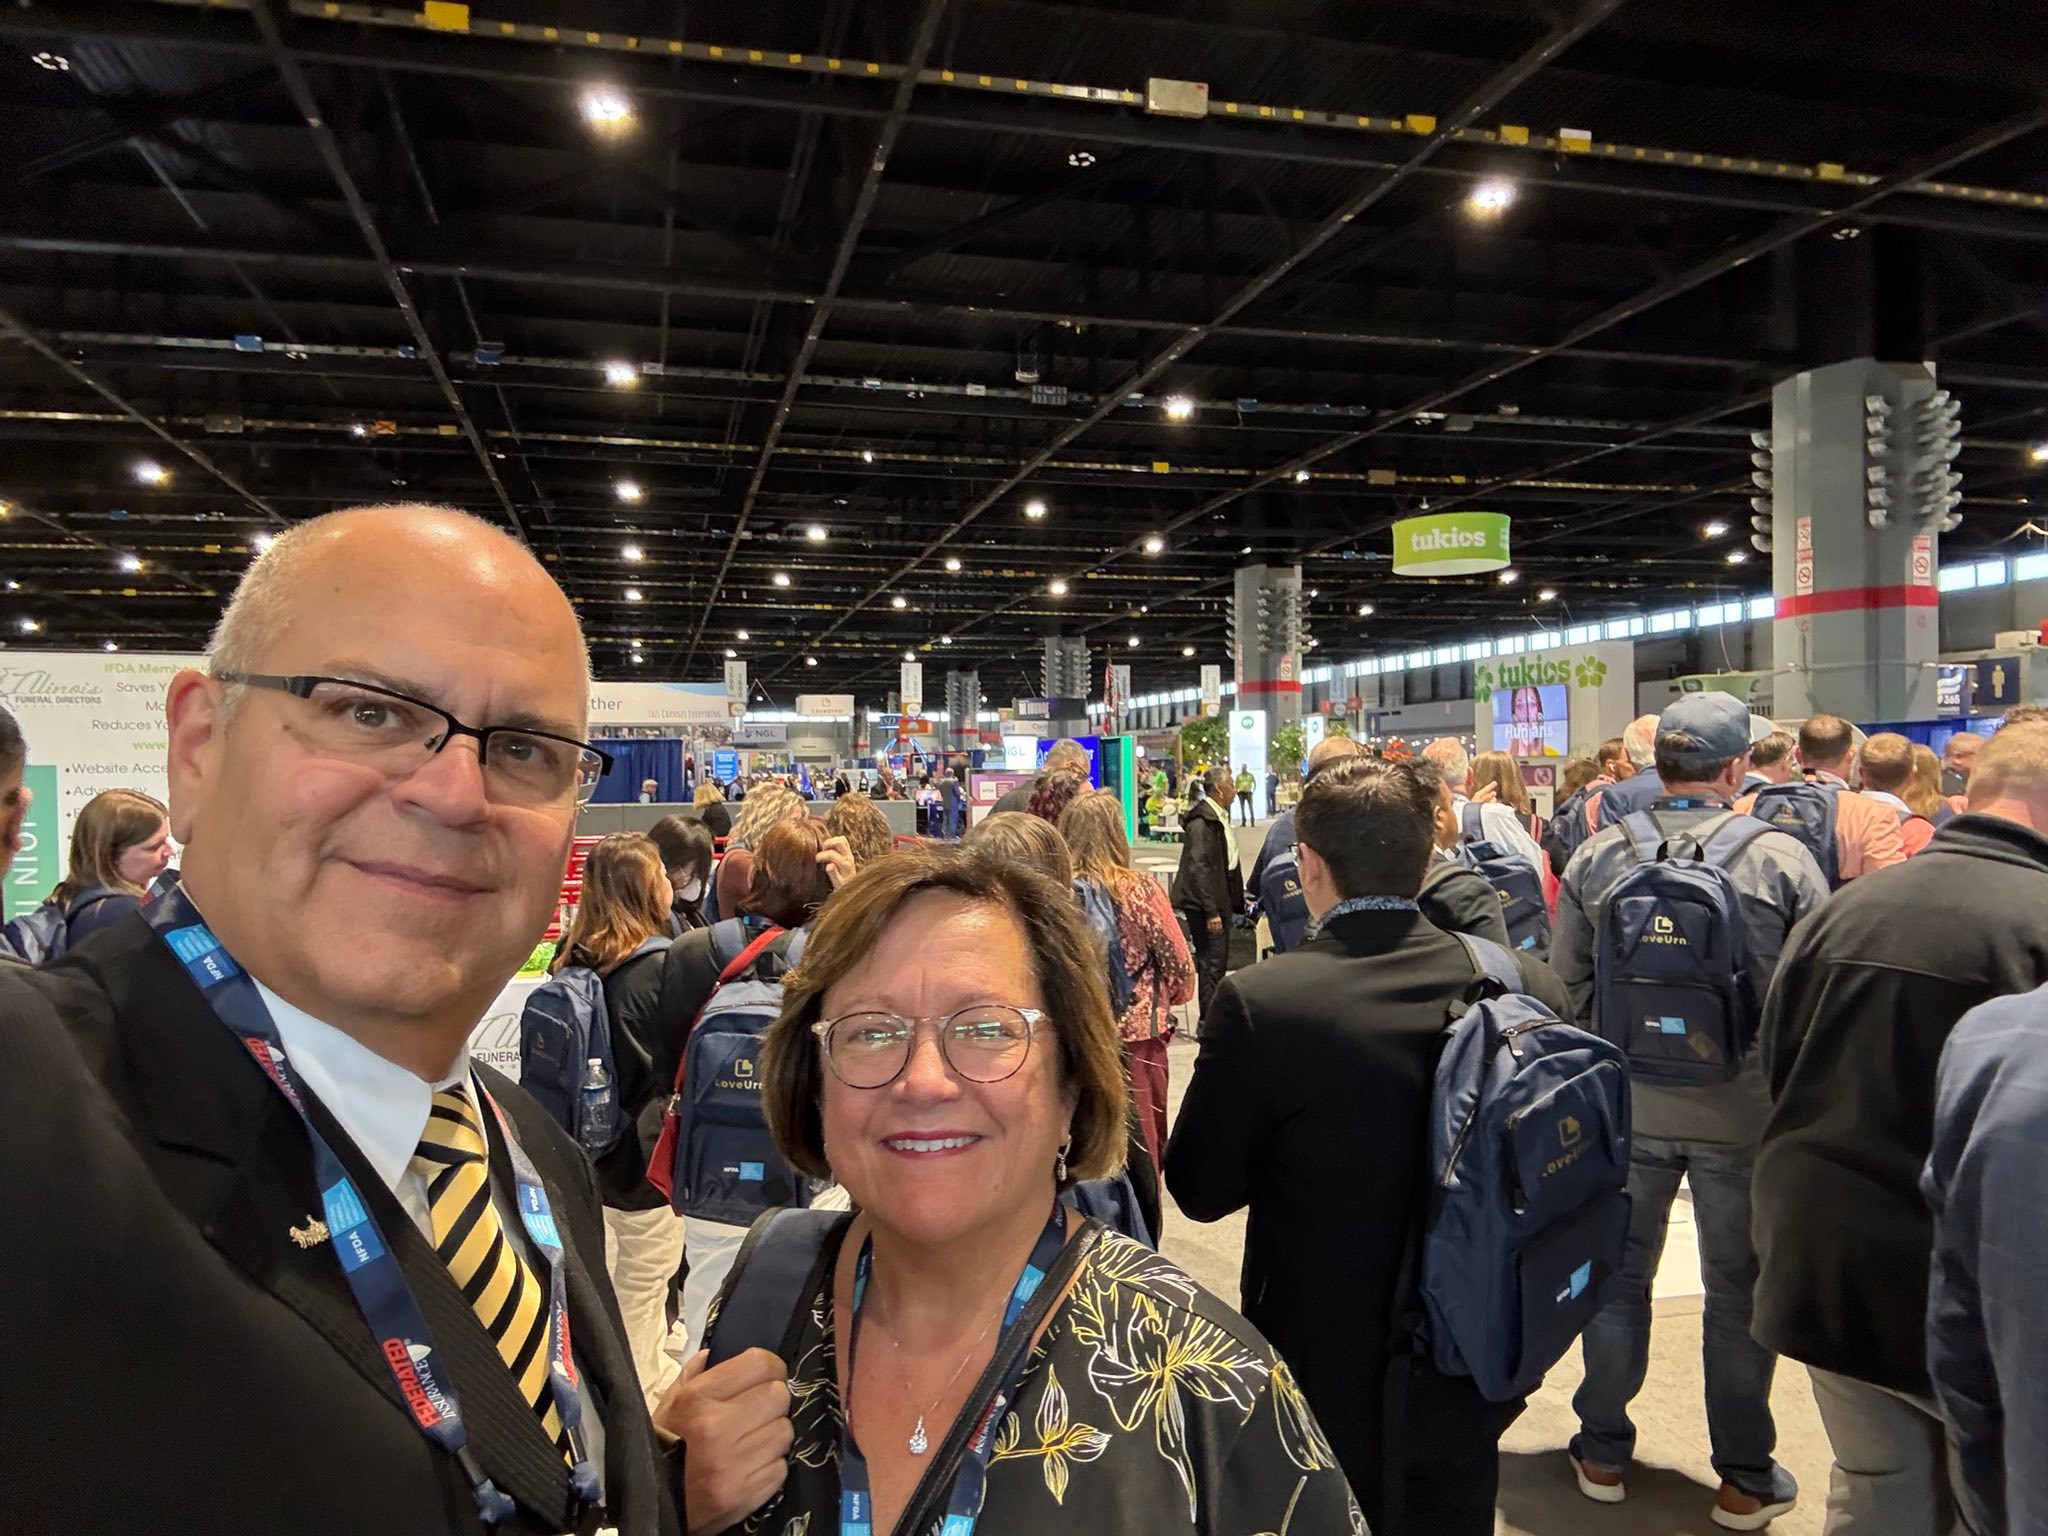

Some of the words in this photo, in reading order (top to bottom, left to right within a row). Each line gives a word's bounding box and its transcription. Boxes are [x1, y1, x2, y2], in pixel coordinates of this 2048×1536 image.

[1411, 526, 1487, 552] tukios
[104, 663, 135, 673] IFDA
[1498, 654, 1571, 688] tukios
[116, 682, 155, 693] Saves
[15, 696, 53, 704] FUNERAL
[56, 696, 102, 704] DIRECTORS
[92, 719, 151, 730] Reduces
[755, 730, 776, 738] NGL
[72, 762, 128, 774] Website
[1640, 934, 1688, 945] oveUrn
[202, 955, 225, 981] NFDA
[348, 1230, 370, 1263] NFDA
[383, 1337, 442, 1428] FEDERATED
[413, 1359, 457, 1419] INSURANCE
